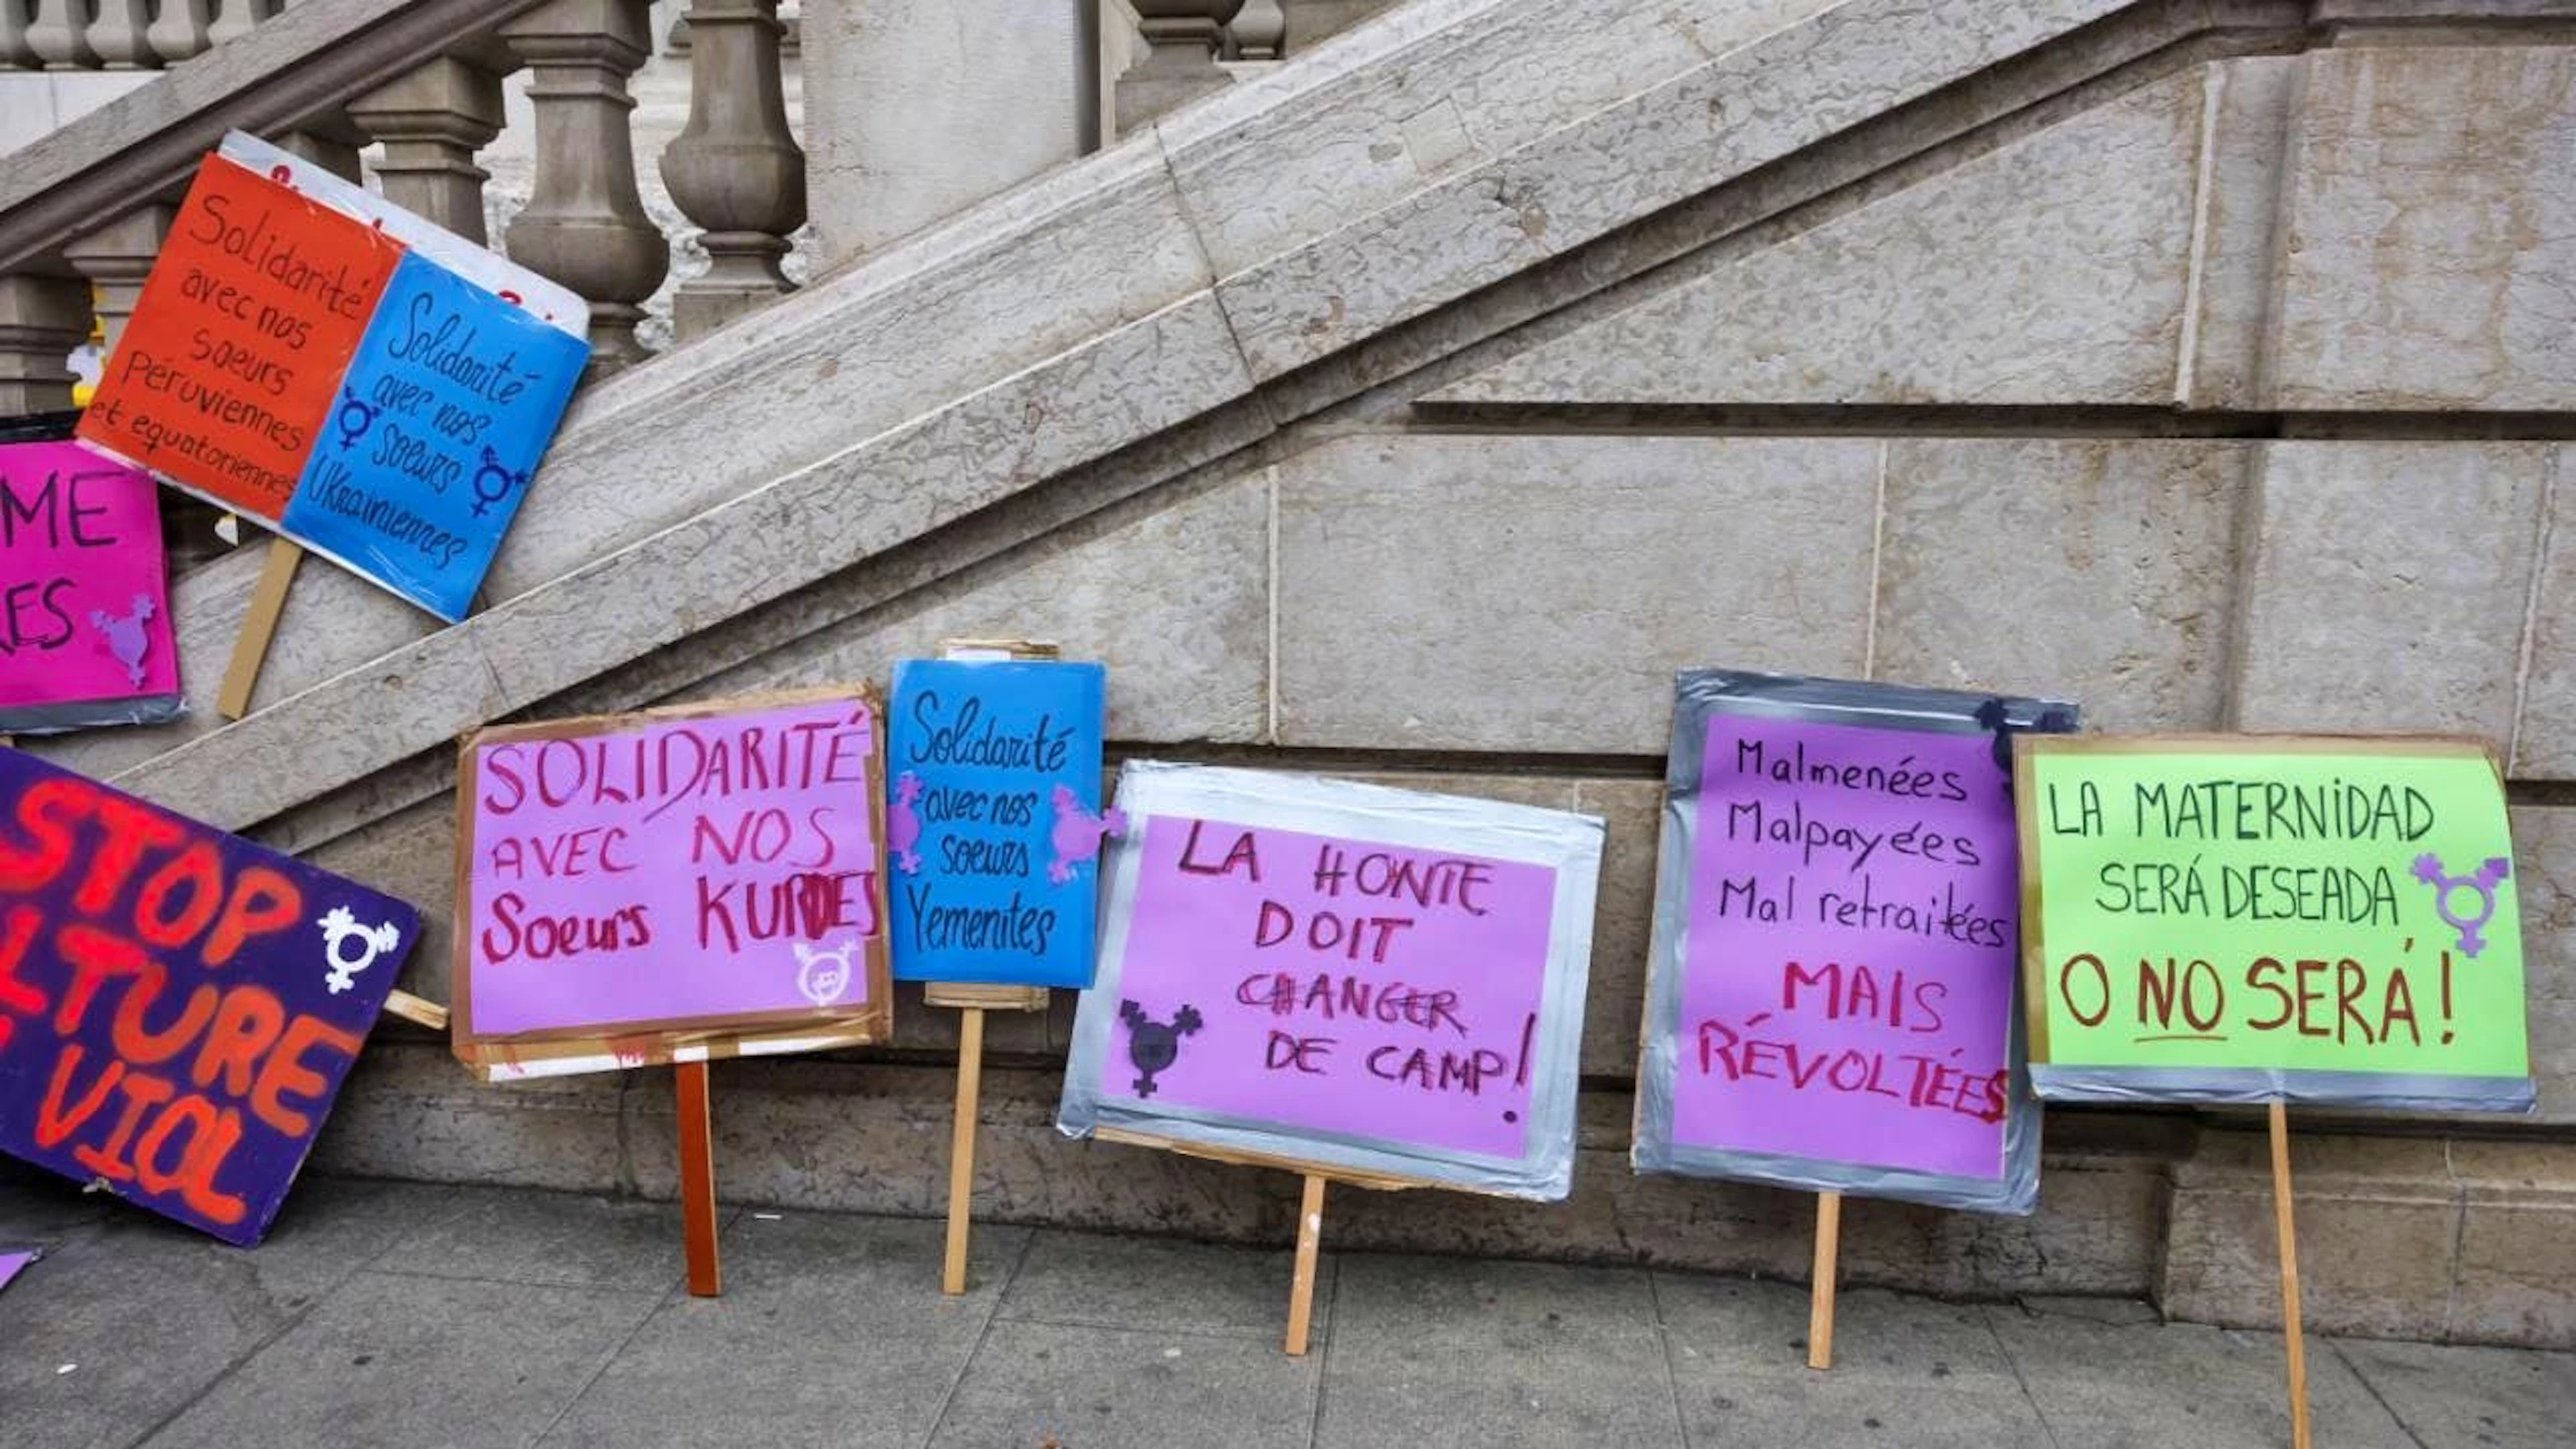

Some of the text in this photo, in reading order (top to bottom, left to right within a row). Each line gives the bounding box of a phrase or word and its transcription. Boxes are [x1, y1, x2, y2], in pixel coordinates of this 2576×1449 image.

[189, 194, 371, 319] Solidarité
[181, 268, 313, 350] avec nos
[387, 291, 542, 407] Solidarité
[91, 399, 121, 427] et
[372, 374, 493, 446] avec nos
[0, 577, 77, 656] ES
[484, 710, 871, 822] SOLIDARITÉ
[910, 690, 1076, 773] Solidarité
[924, 790, 1038, 828] avec nos
[1736, 738, 1968, 804] Malmenées
[2048, 780, 2104, 838] LA
[0, 777, 305, 969] STOP
[490, 807, 838, 880] AVEC NOS
[1177, 818, 1498, 916] LA HONTE
[1727, 800, 1982, 873] Malpayées
[906, 883, 1056, 957] Yemenites
[1719, 873, 2012, 949] Mal retraitées
[2094, 853, 2400, 927] SERÁ DESEADA
[1254, 900, 1415, 964] DOIT
[1235, 971, 1470, 1038] CHANGER
[1782, 961, 1949, 1034] MAIS
[2059, 953, 2110, 1028] O
[2137, 956, 2226, 1032] NO
[1265, 1012, 1538, 1125] DE CAMP!
[1697, 1012, 2011, 1125] RÉVOLTÉES
[32, 1042, 250, 1226] VIOL
